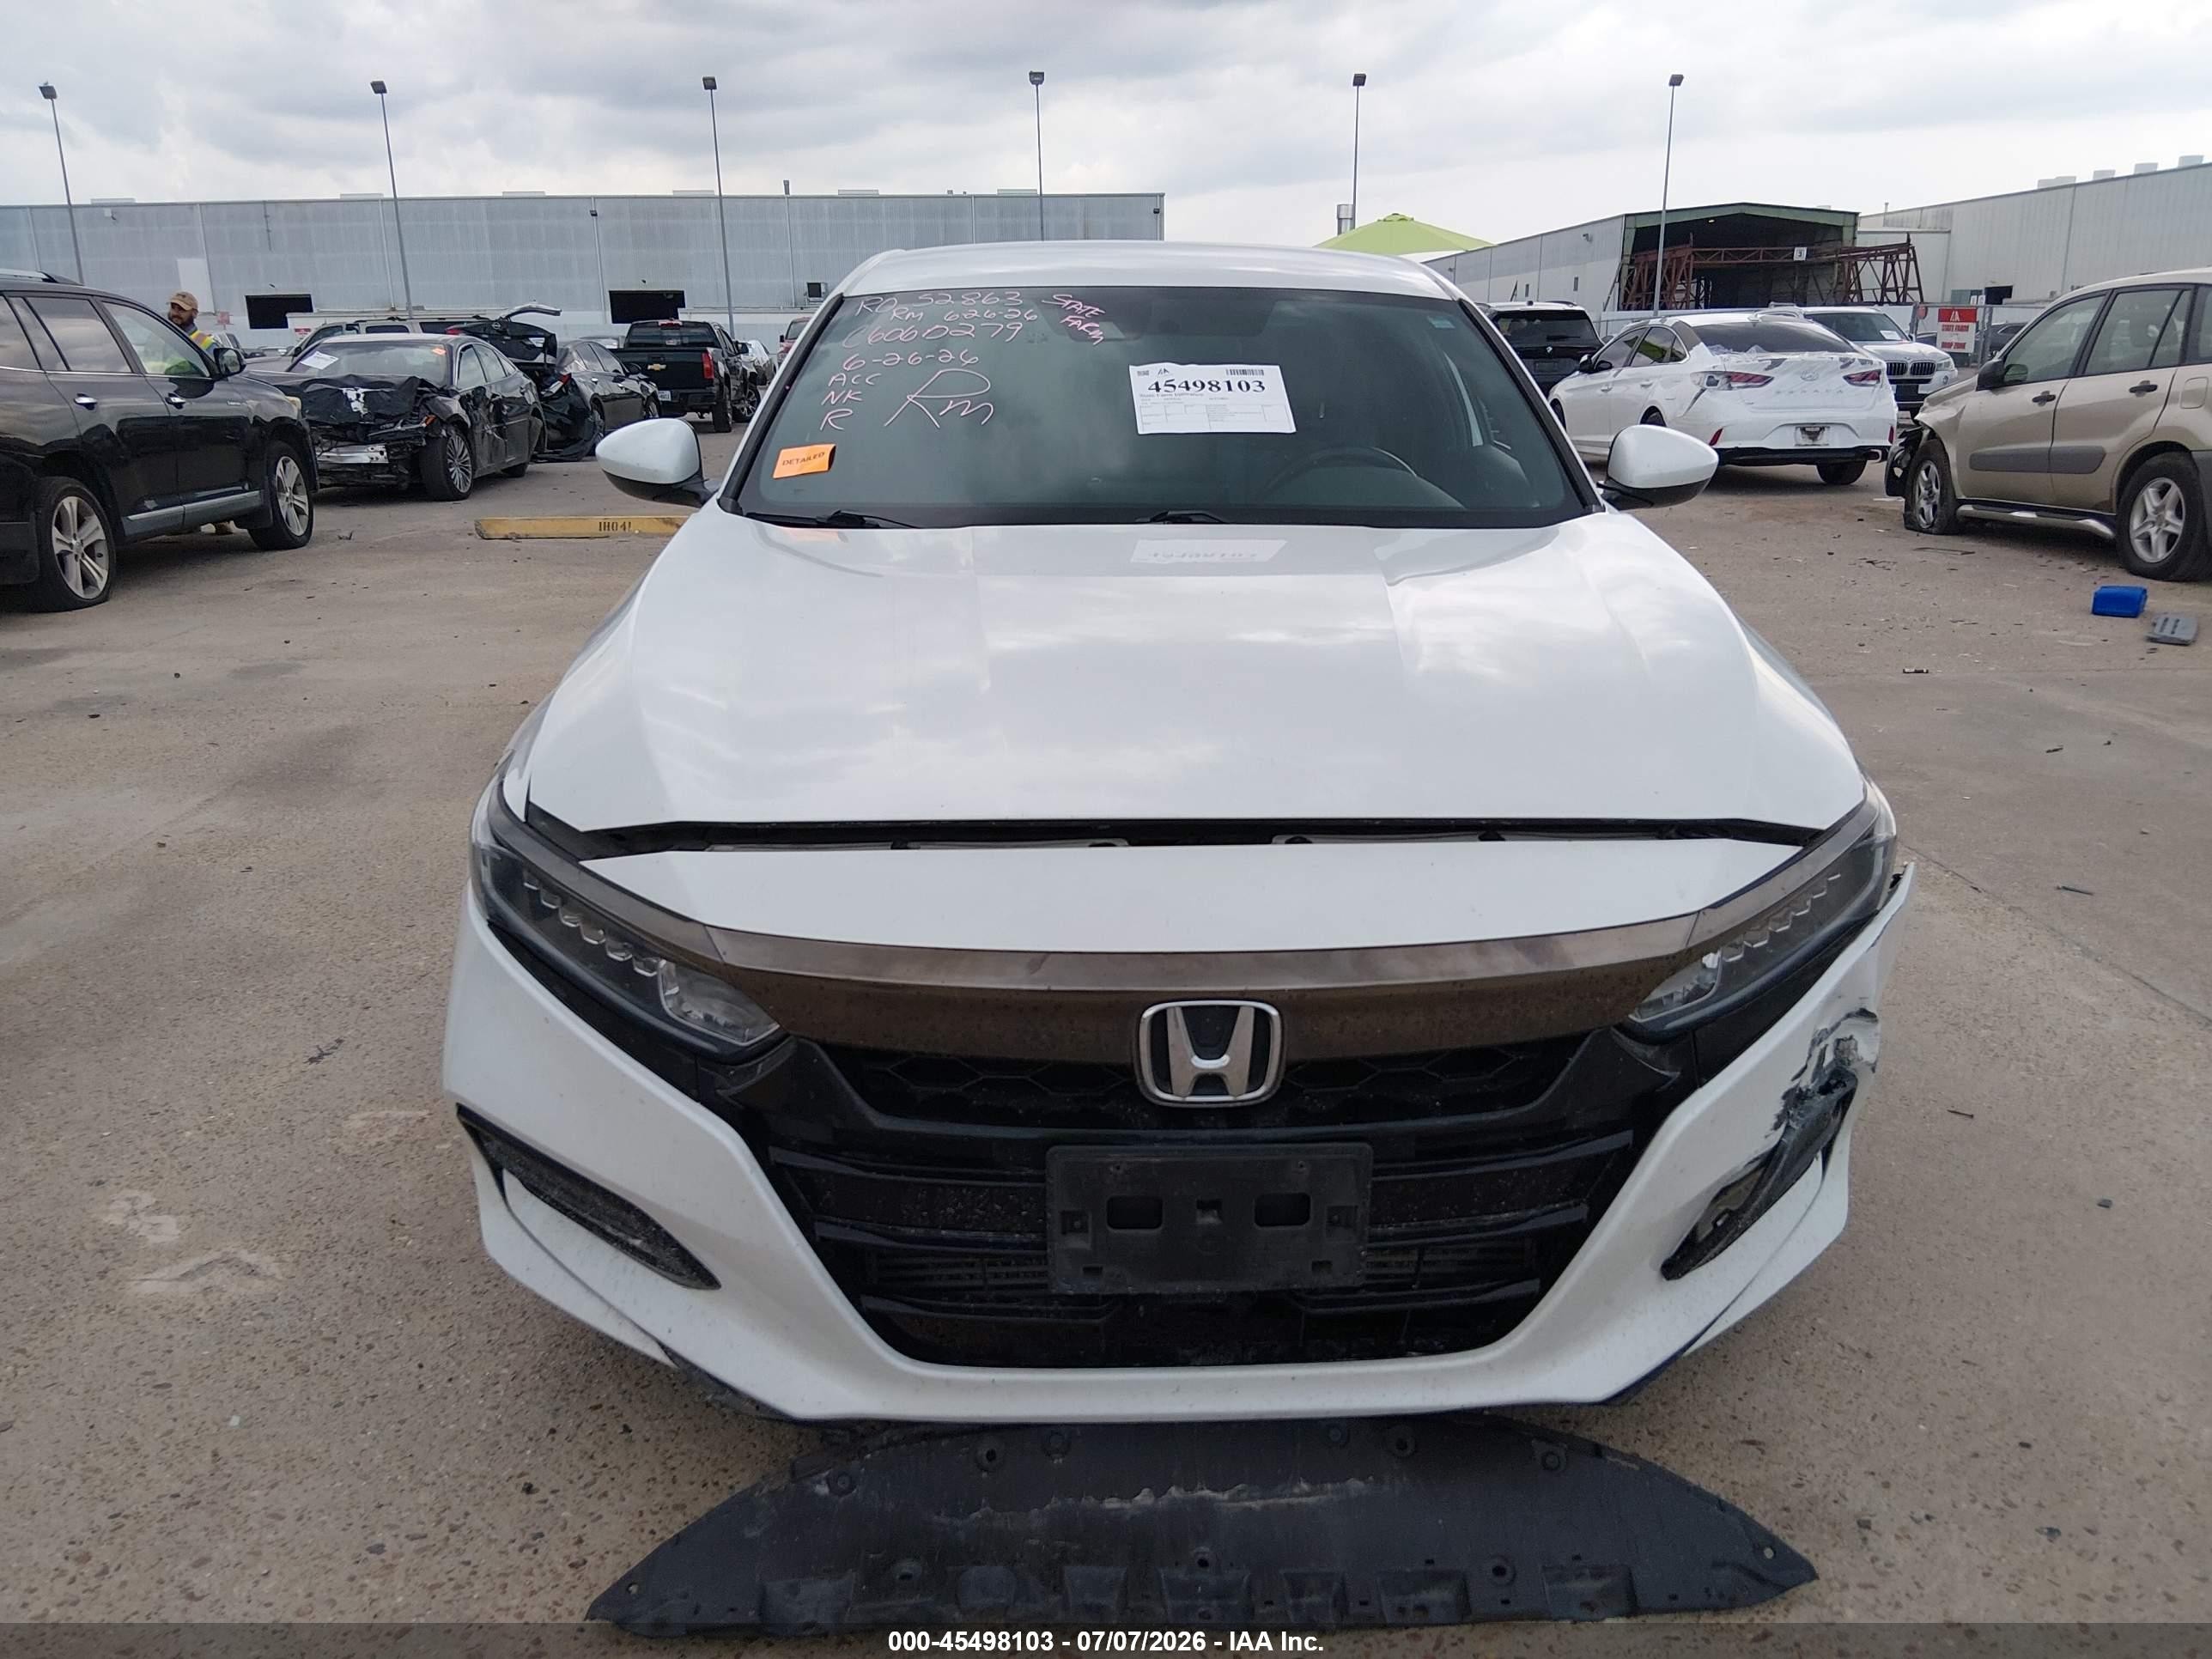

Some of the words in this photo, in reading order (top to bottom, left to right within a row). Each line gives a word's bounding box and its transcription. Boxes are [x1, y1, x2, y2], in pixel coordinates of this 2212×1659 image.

[1041, 294, 1106, 318] STATE
[1059, 315, 1104, 345] FARM
[828, 373, 881, 386] ACC
[1147, 378, 1266, 393] 45498103
[821, 390, 863, 405] NK
[820, 408, 853, 431] R
[781, 451, 825, 466] DETAILED
